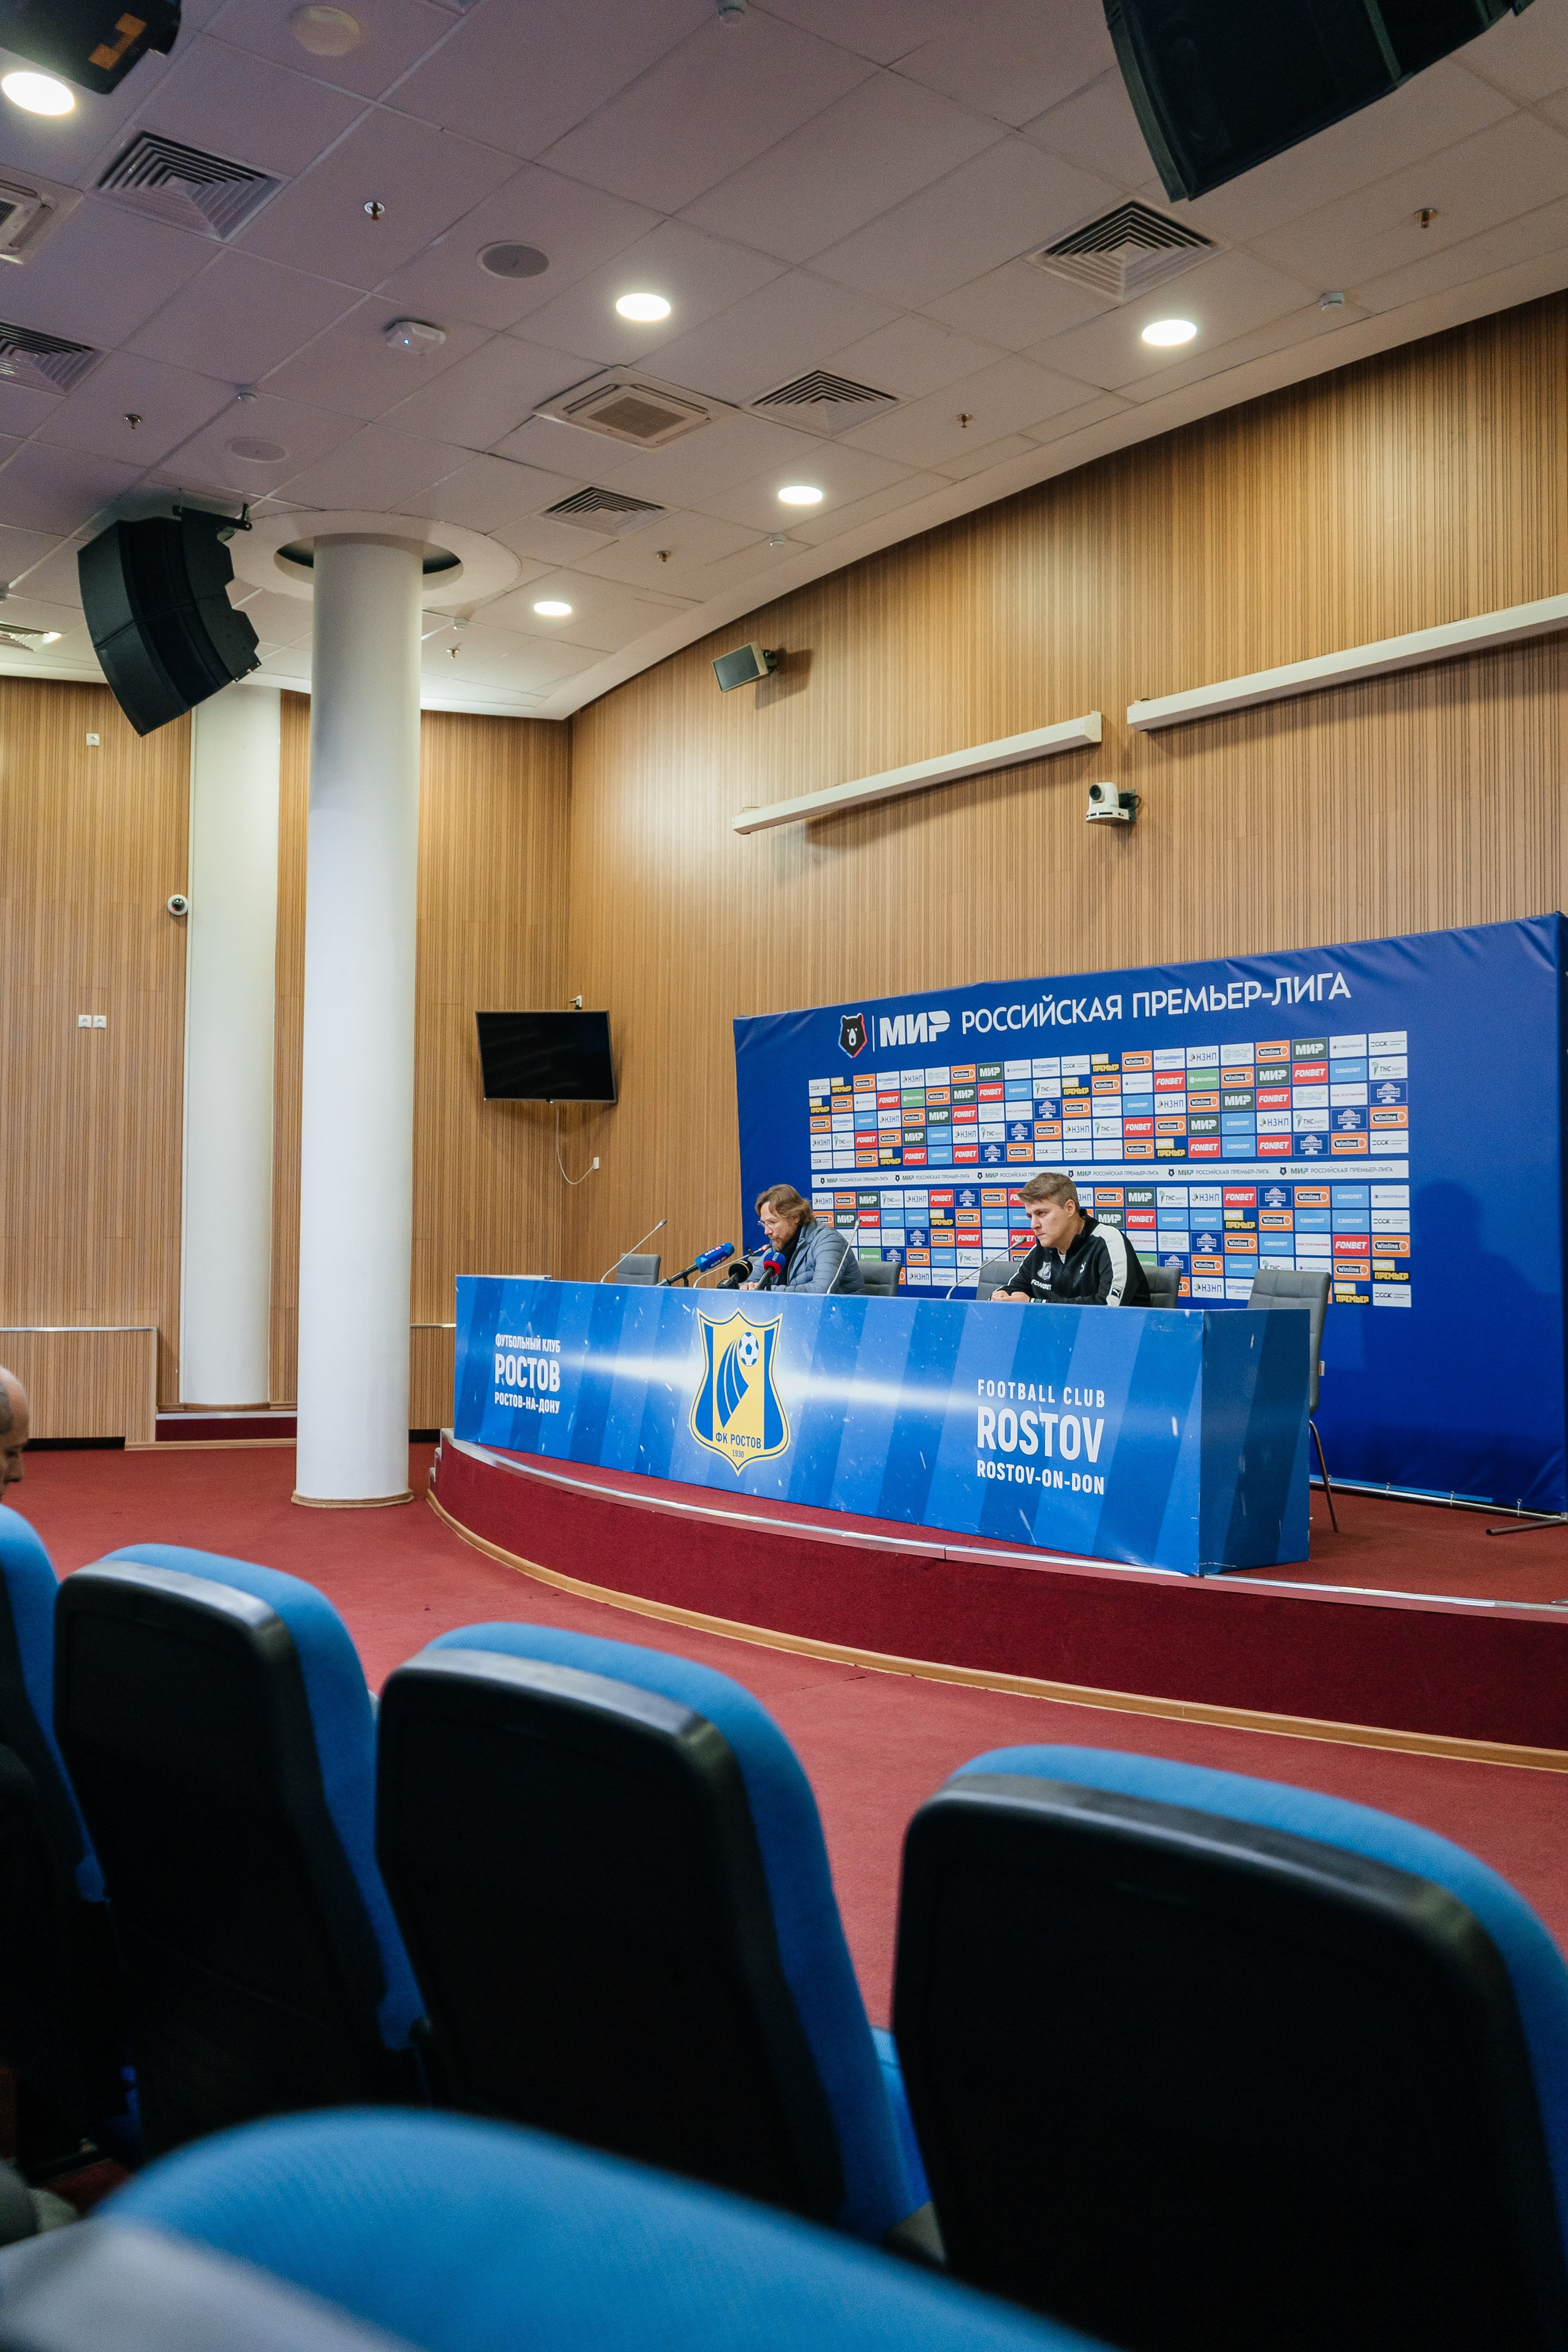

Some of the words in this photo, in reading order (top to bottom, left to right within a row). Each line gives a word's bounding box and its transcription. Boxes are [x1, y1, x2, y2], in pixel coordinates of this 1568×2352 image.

[880, 1010, 950, 1047] МИР
[962, 994, 1122, 1035] РОССИЙСКАЯ
[1133, 971, 1351, 1018] ПРЕМЬЕР-ЛИГА
[1295, 1043, 1324, 1055] МИР
[1196, 1052, 1216, 1061] НЗНП
[979, 1066, 1000, 1077] МИР
[1093, 1063, 1118, 1072] ПРЕМЬЕР
[1294, 1068, 1325, 1077] FONBET
[1259, 1069, 1287, 1080] МИР
[1156, 1077, 1183, 1085] FONBET
[954, 1089, 974, 1099] МИР
[1063, 1087, 1088, 1095] ПРЕМЬЕР
[1164, 1099, 1183, 1108] НЗНП
[1224, 1095, 1251, 1106] МИР
[1258, 1094, 1288, 1103] FONBET
[929, 1111, 948, 1120] МИР
[1191, 1119, 1216, 1129] МИР
[1267, 1117, 1288, 1126] НЗНП
[904, 1133, 923, 1141] МИР
[1189, 1143, 1218, 1152] FONBET
[1259, 1141, 1289, 1150] FONBET
[1128, 1192, 1152, 1202] МИР
[1098, 1213, 1121, 1223] МИР
[1374, 1272, 1408, 1280] ПРЕМЬЕР
[1031, 1279, 1051, 1291] FONBET
[1202, 1284, 1221, 1292] НЗНП
[495, 1333, 541, 1351] ФУТБОЛЬНЫЙ
[542, 1339, 560, 1353] КЛУБ
[495, 1353, 560, 1392] РОСТОВ
[978, 1379, 1055, 1403] FOOTBALL
[1063, 1387, 1105, 1408] CLUB
[494, 1392, 560, 1414] РОСТОВ-НА-ДОНУ
[977, 1406, 1104, 1463] ROSTOV
[715, 1432, 728, 1444] ФК
[730, 1434, 761, 1449] РОСТОВ
[977, 1460, 1104, 1495] ROSTOV-ON-DON
